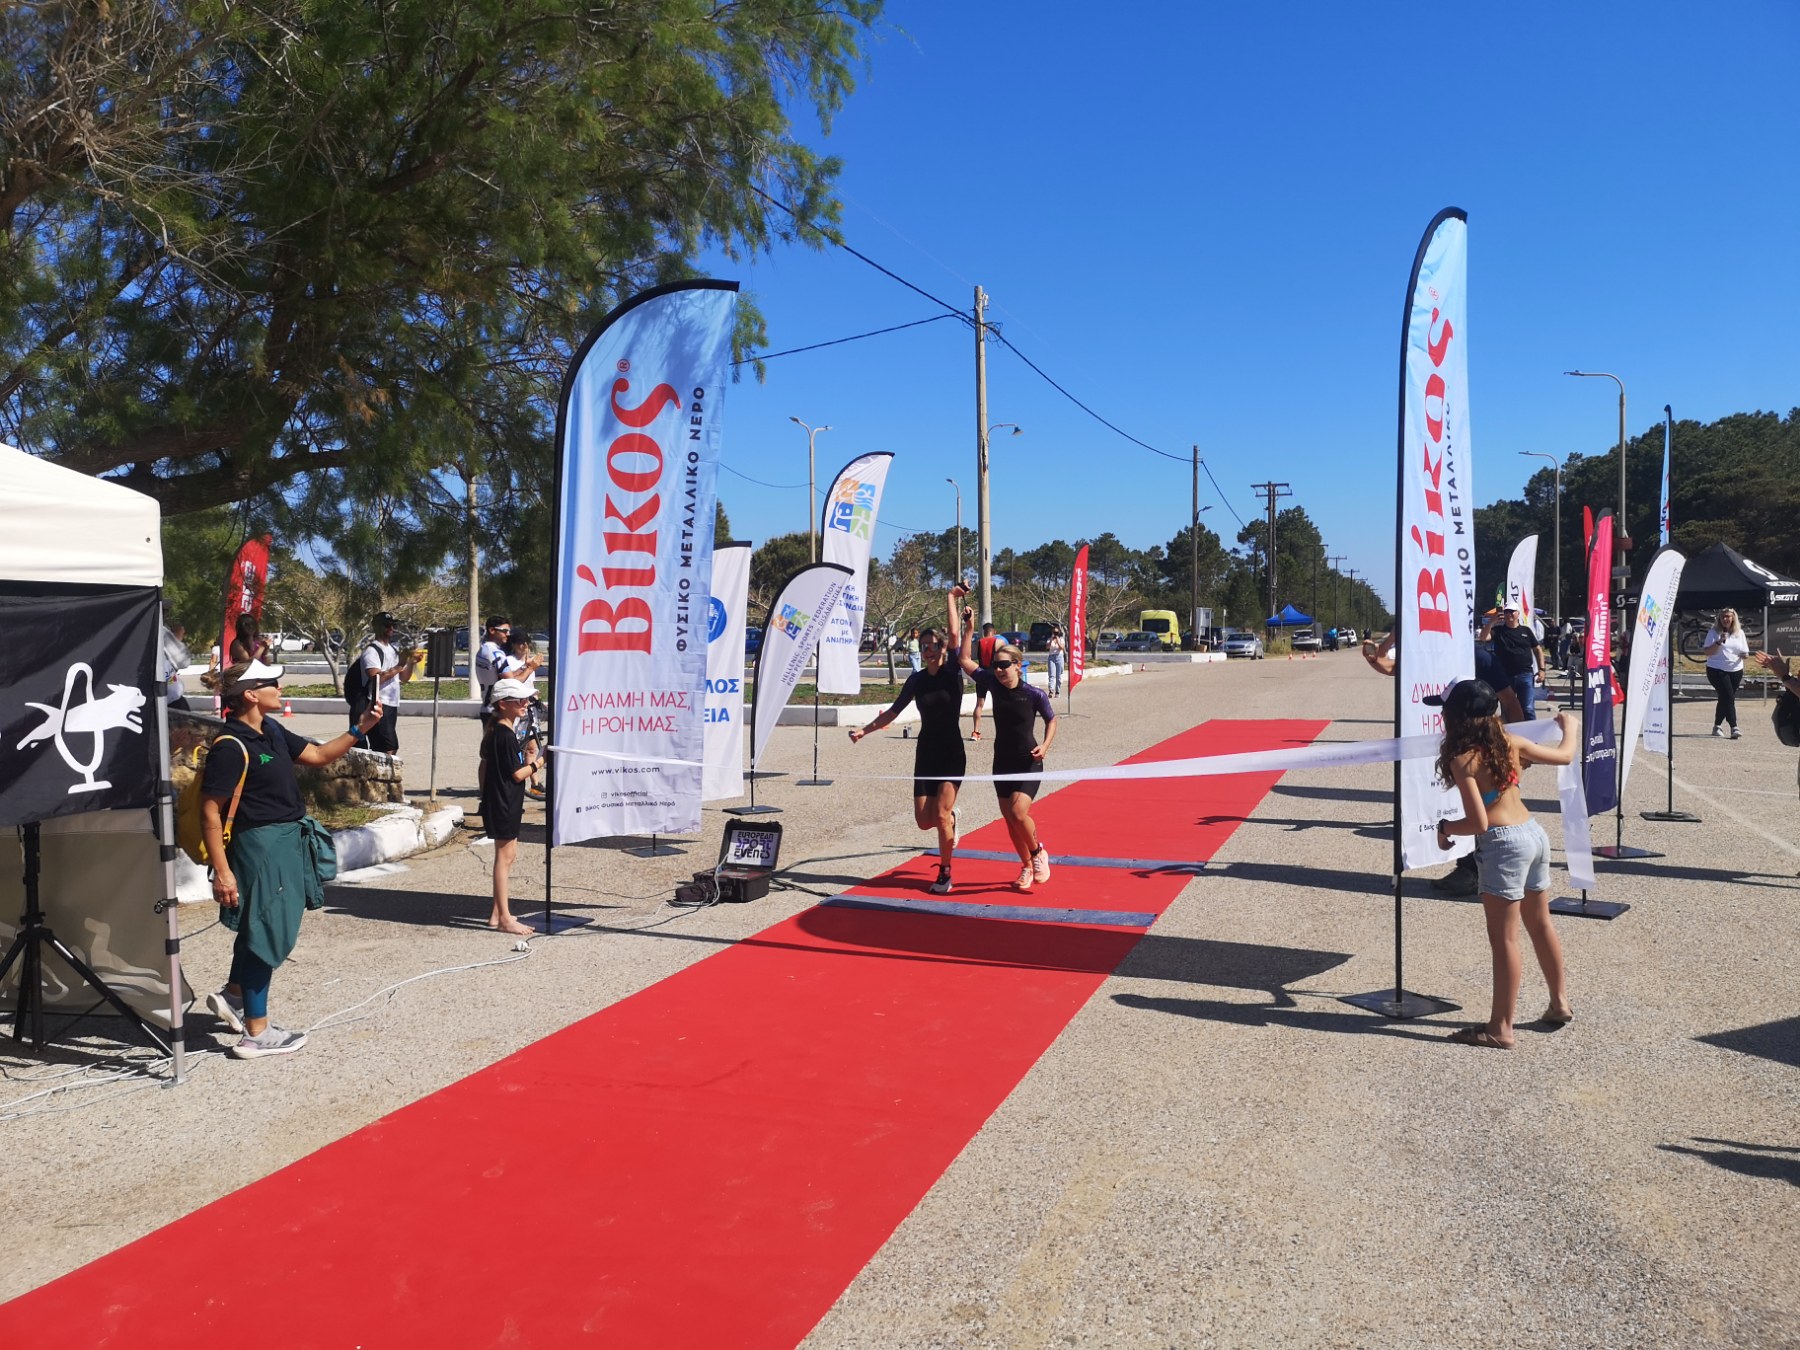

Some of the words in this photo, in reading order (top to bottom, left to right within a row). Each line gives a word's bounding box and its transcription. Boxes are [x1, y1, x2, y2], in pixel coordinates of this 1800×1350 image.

[689, 387, 704, 440] ΝΕΡΟ
[680, 451, 699, 567] ΜΕΤΑΛΛΙΚΟ
[676, 578, 691, 652] ΦΥΣΙΚΟ
[780, 652, 800, 683] HELLENIC
[798, 624, 814, 650] SPORTS
[812, 581, 837, 622] FEDERATION
[786, 672, 797, 686] FOR
[793, 643, 812, 672] PERSONS
[818, 585, 843, 626] DISABILITIES
[567, 691, 644, 711] ΔΥΝΑΜΗ
[650, 691, 690, 711] ΜΑΣ,
[582, 718, 593, 735] Η
[598, 716, 634, 734] ΡΟΗ
[638, 716, 678, 732] ΜΑΣ.
[591, 766, 660, 776] www.vikos.com
[736, 839, 773, 851] SPORT
[737, 831, 774, 840] EUROPEAN
[733, 849, 770, 859] EVENTS
